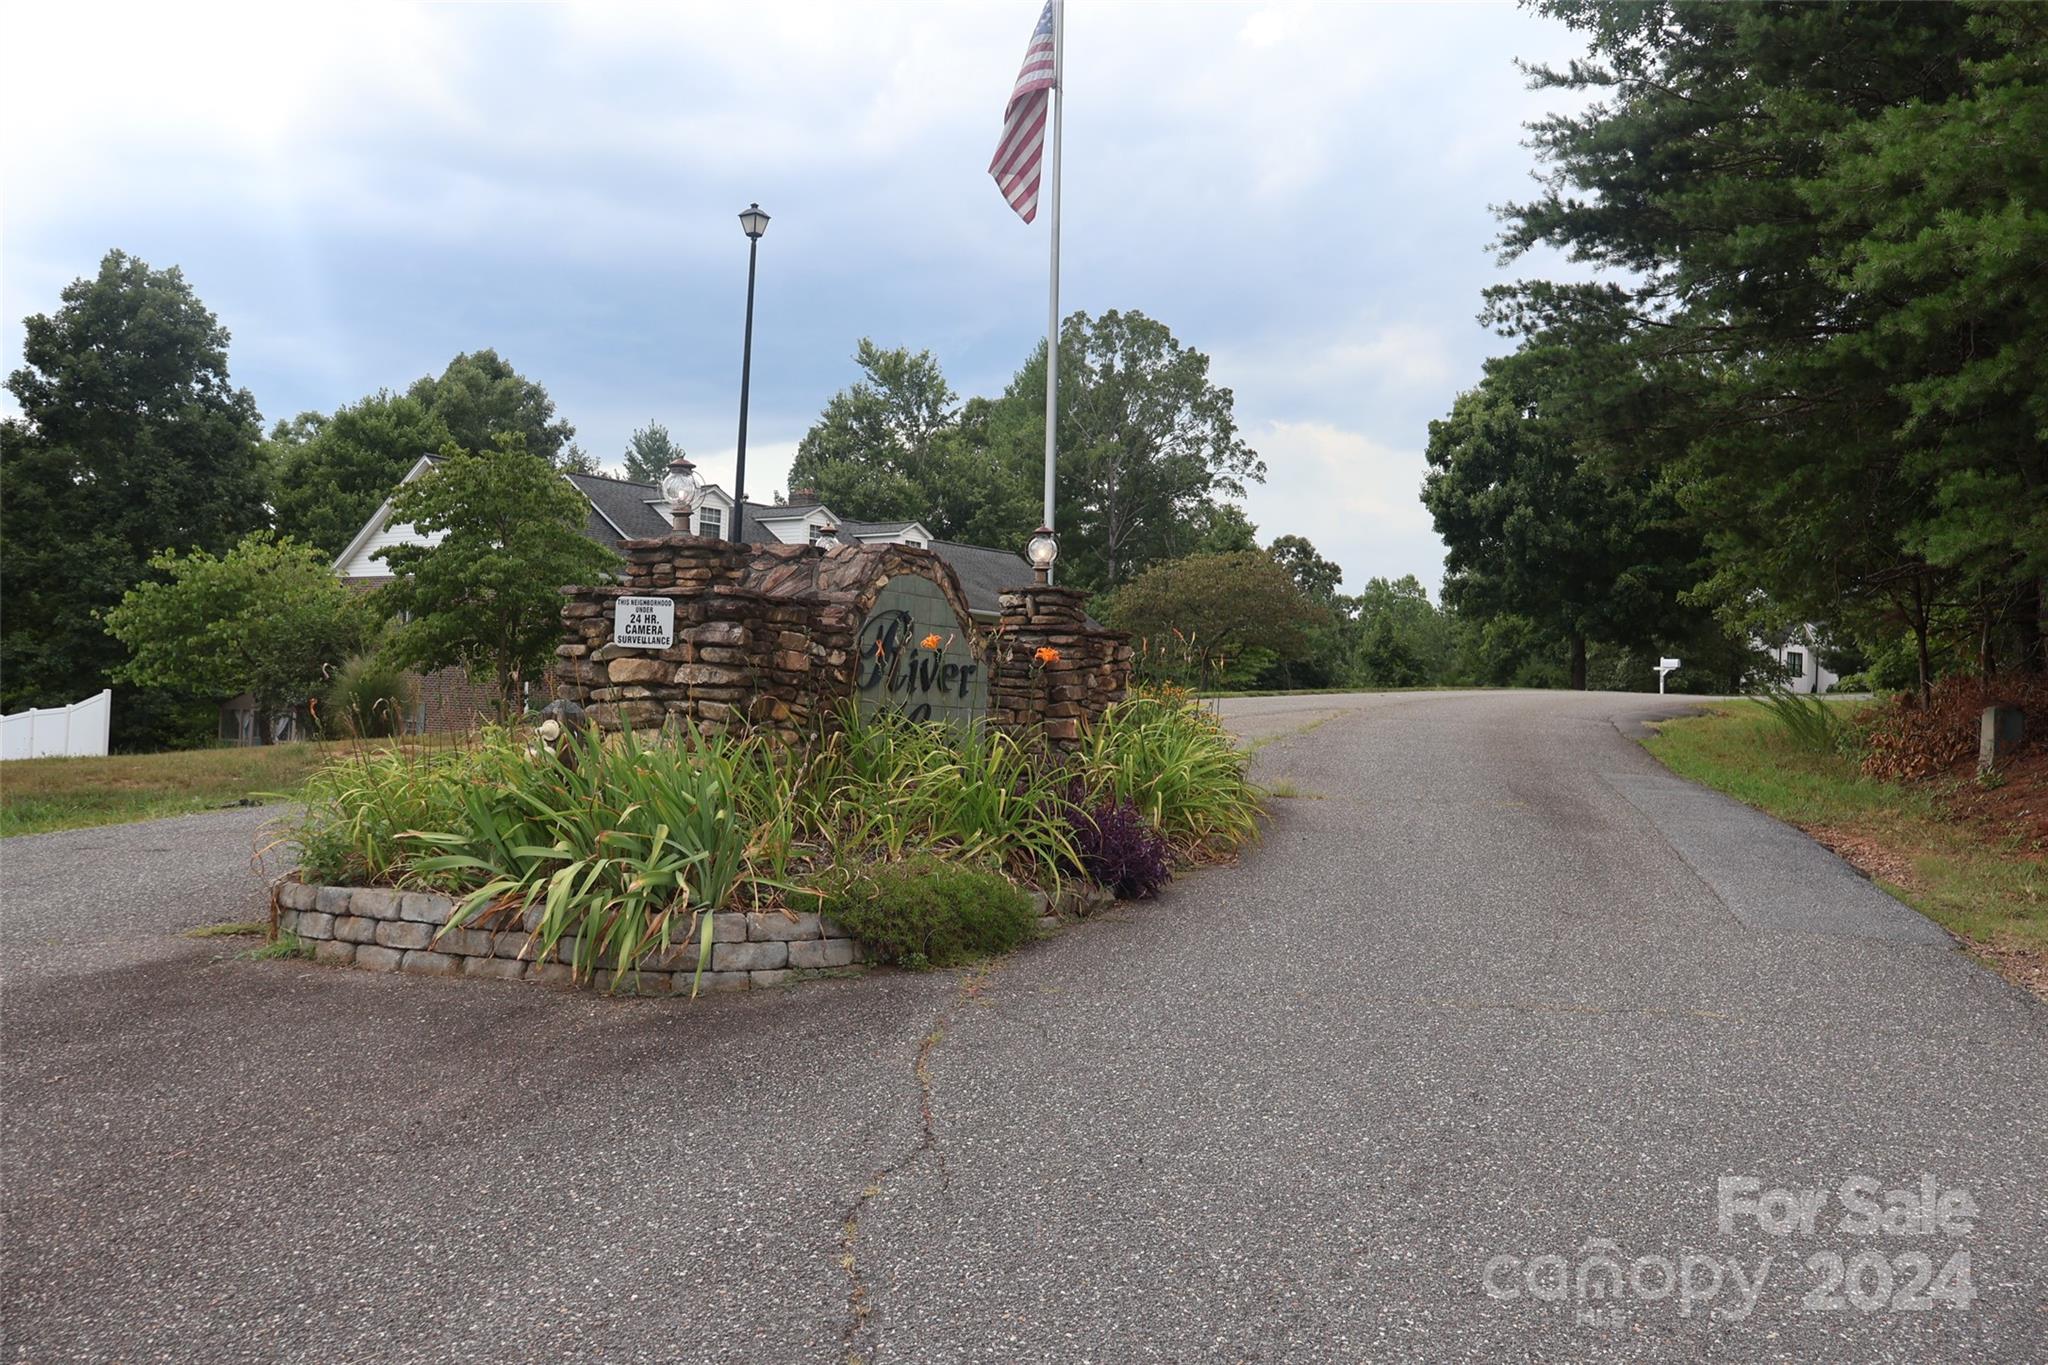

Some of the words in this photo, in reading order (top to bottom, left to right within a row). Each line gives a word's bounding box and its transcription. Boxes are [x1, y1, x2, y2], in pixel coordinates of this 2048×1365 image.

[630, 614, 641, 624] 24
[644, 614, 659, 624] HR.
[625, 625, 663, 635] CAMERA
[617, 636, 670, 645] SURVEILLANCE
[856, 610, 976, 698] River
